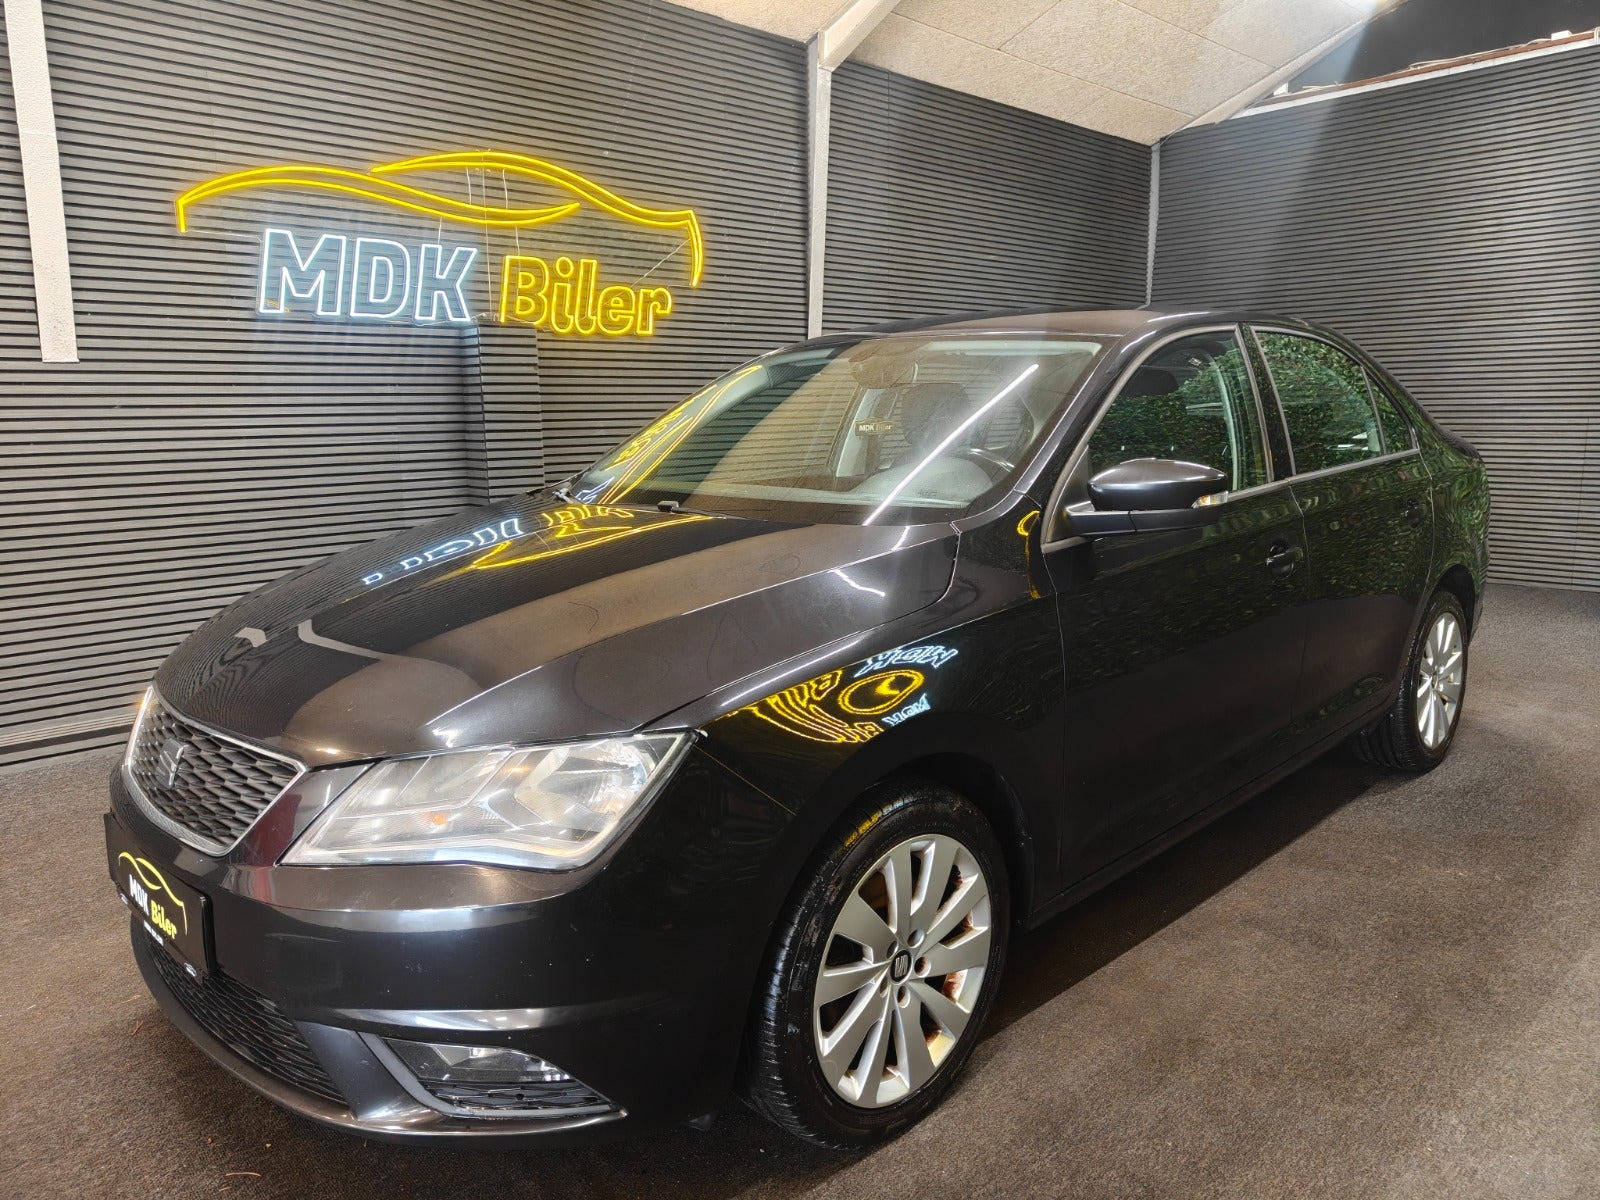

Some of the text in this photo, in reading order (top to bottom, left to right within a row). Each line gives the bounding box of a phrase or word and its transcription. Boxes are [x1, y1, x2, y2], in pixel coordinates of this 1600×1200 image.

[257, 228, 674, 337] MDK Biler
[129, 874, 149, 915] MDK
[151, 900, 177, 939] Biler
